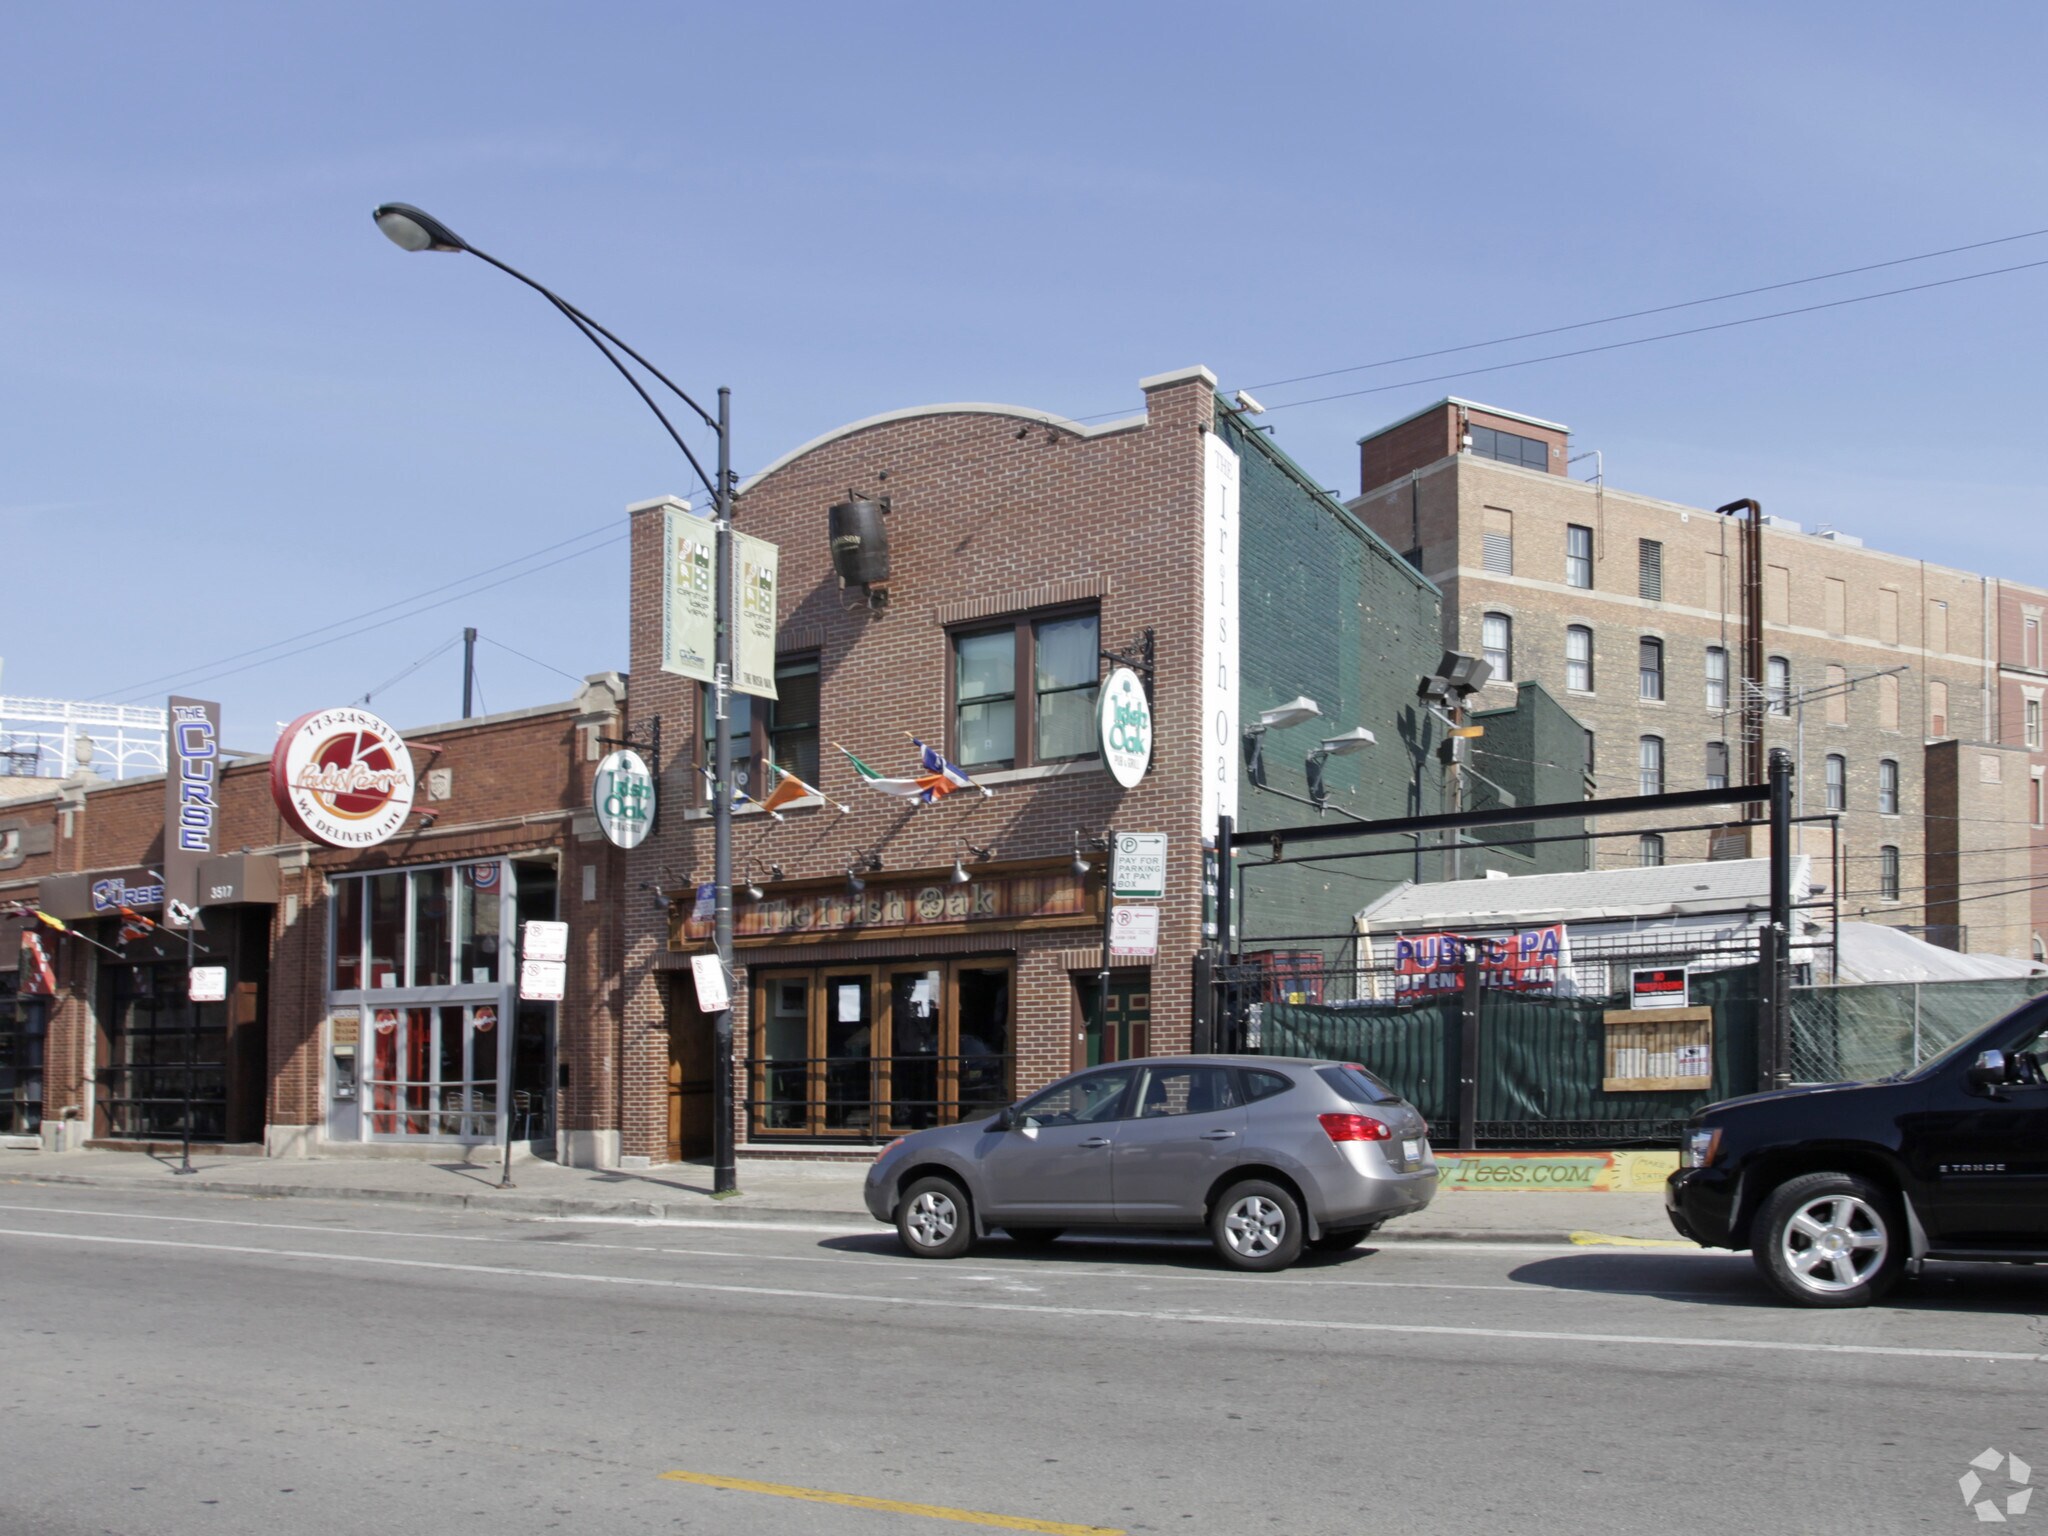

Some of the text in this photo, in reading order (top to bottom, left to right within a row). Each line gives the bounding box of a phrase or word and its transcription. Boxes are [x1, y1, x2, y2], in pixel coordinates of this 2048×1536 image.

[172, 705, 207, 721] THE
[303, 711, 403, 752] 773-248-3111
[1109, 721, 1146, 756] Oak
[174, 720, 219, 852] CURSE
[607, 769, 652, 799] Irish
[298, 798, 401, 842] WE DELIVER LATE
[603, 794, 649, 820] Oak
[1119, 865, 1160, 873] PARKING
[210, 885, 233, 899] 3517
[758, 899, 813, 930] The
[818, 890, 905, 928] Irish
[916, 883, 994, 919] Oak
[1395, 971, 1456, 992] OPEN
